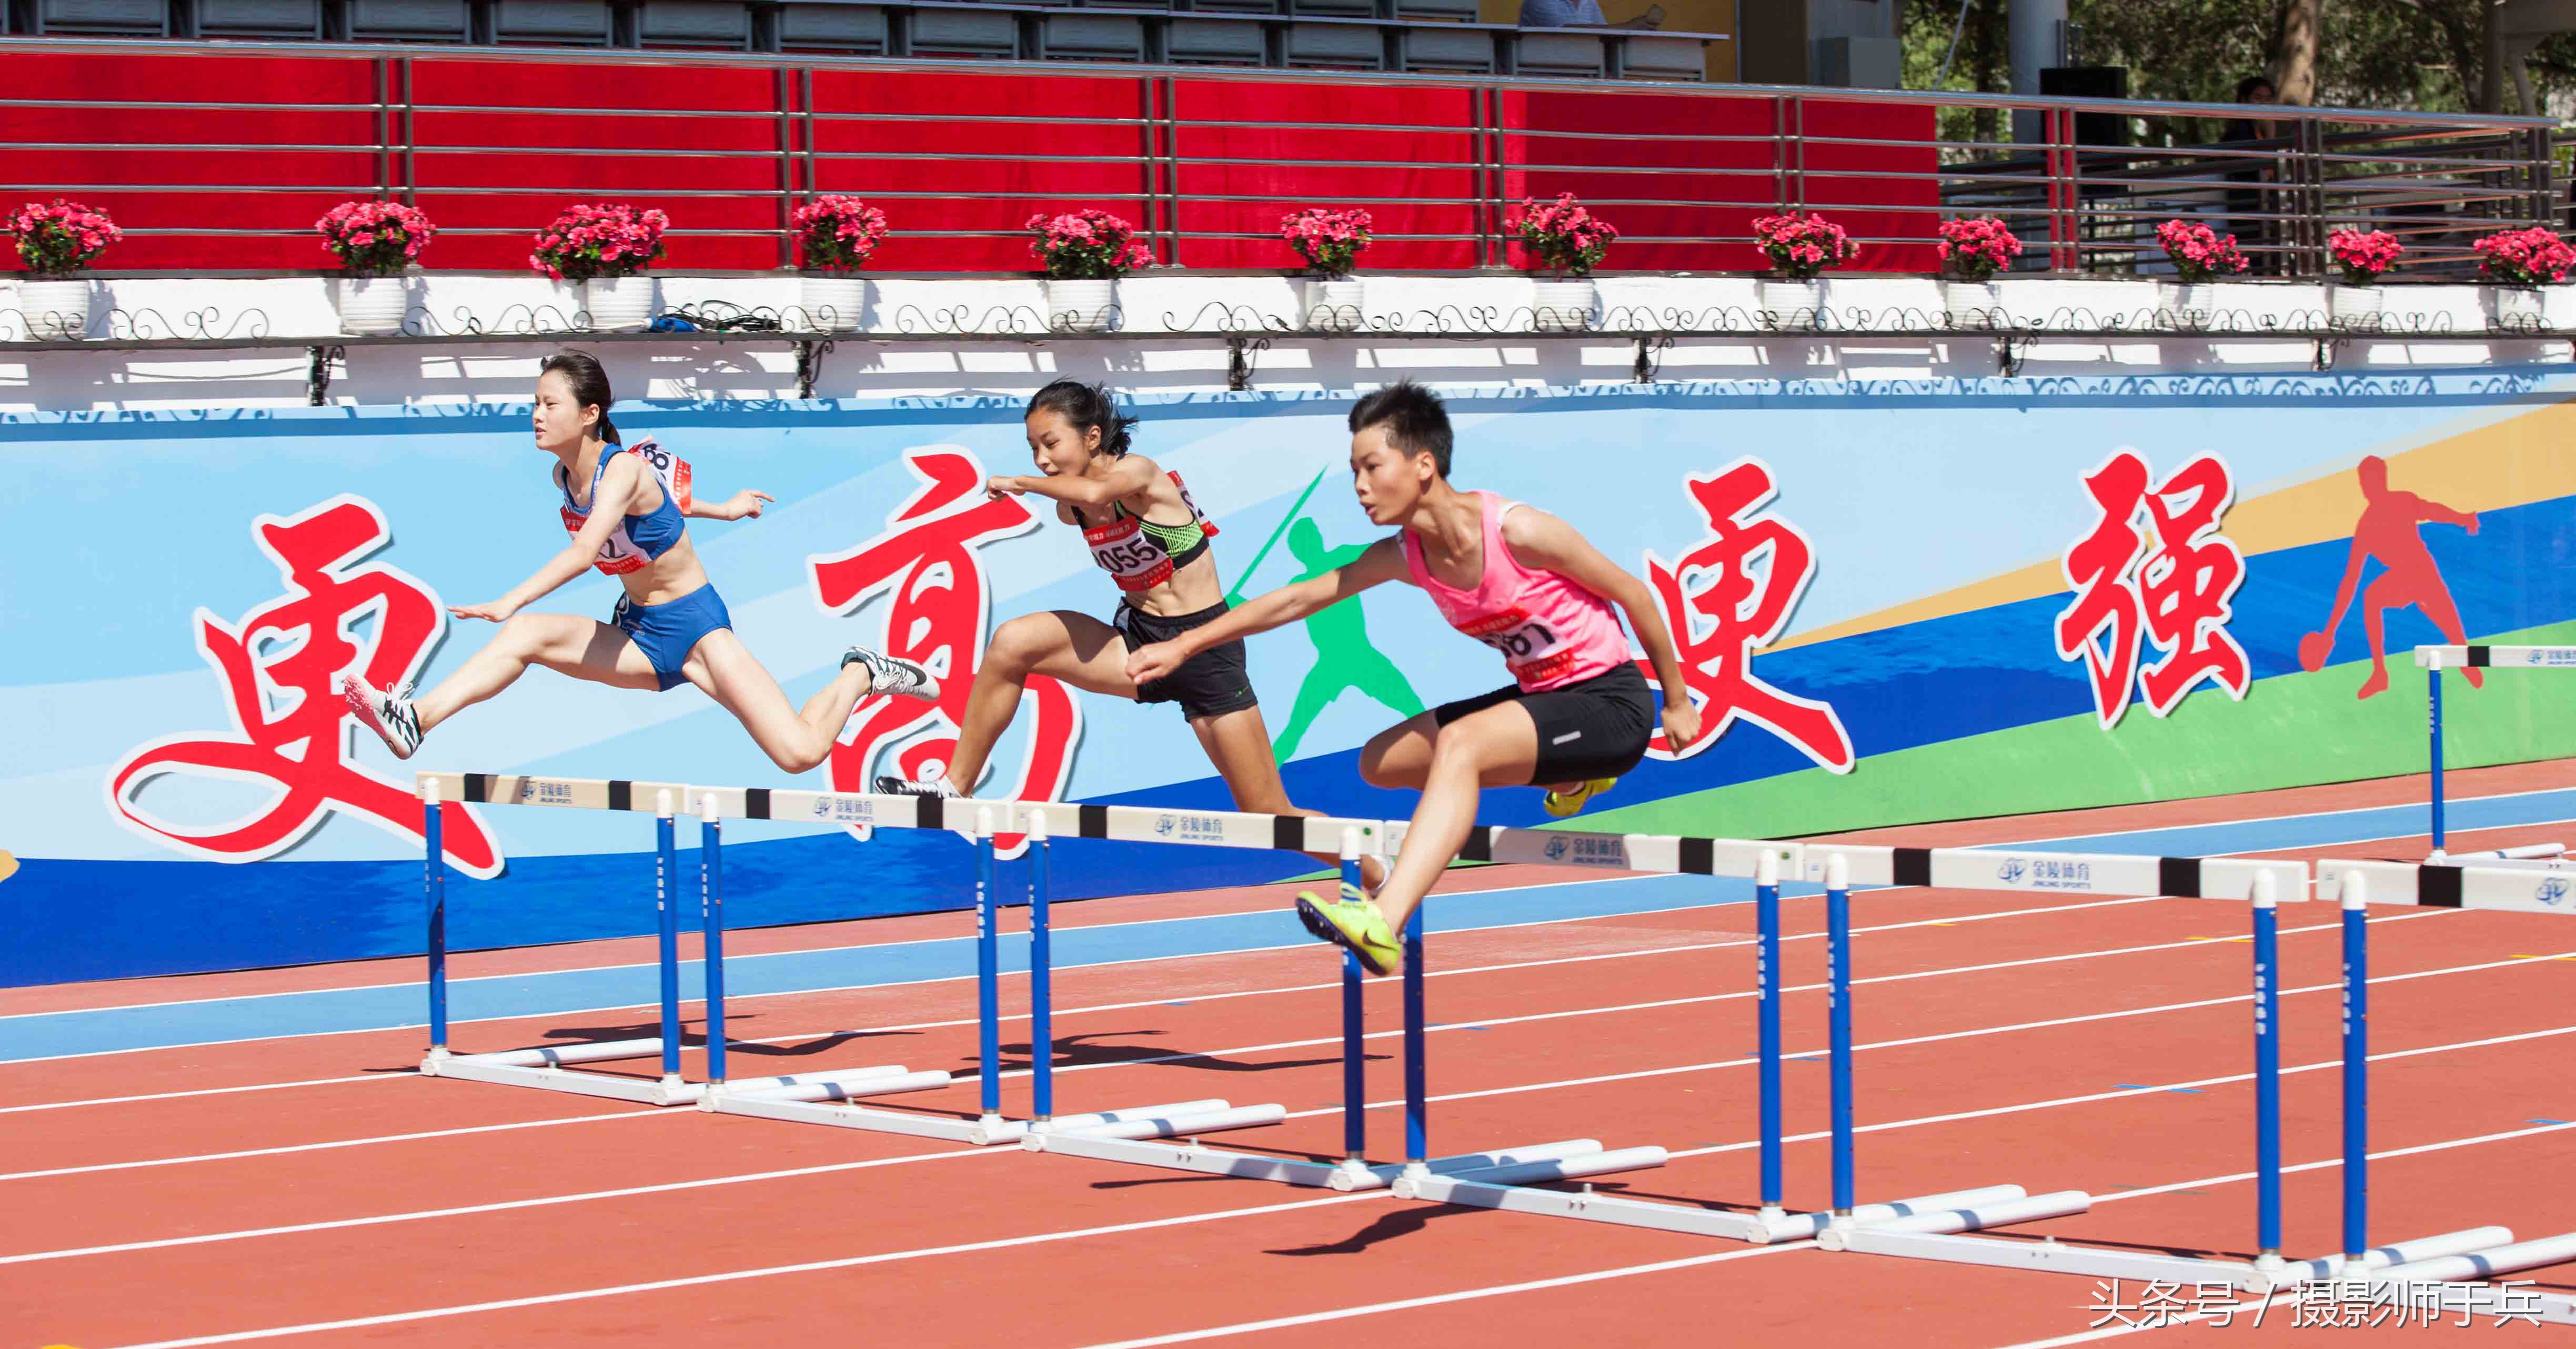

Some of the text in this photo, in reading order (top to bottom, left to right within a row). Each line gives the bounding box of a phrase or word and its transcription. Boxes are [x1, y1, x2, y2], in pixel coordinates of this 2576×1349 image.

[110, 451, 2245, 870] 更 高 更 强
[2032, 860, 2089, 881] 金陵体育
